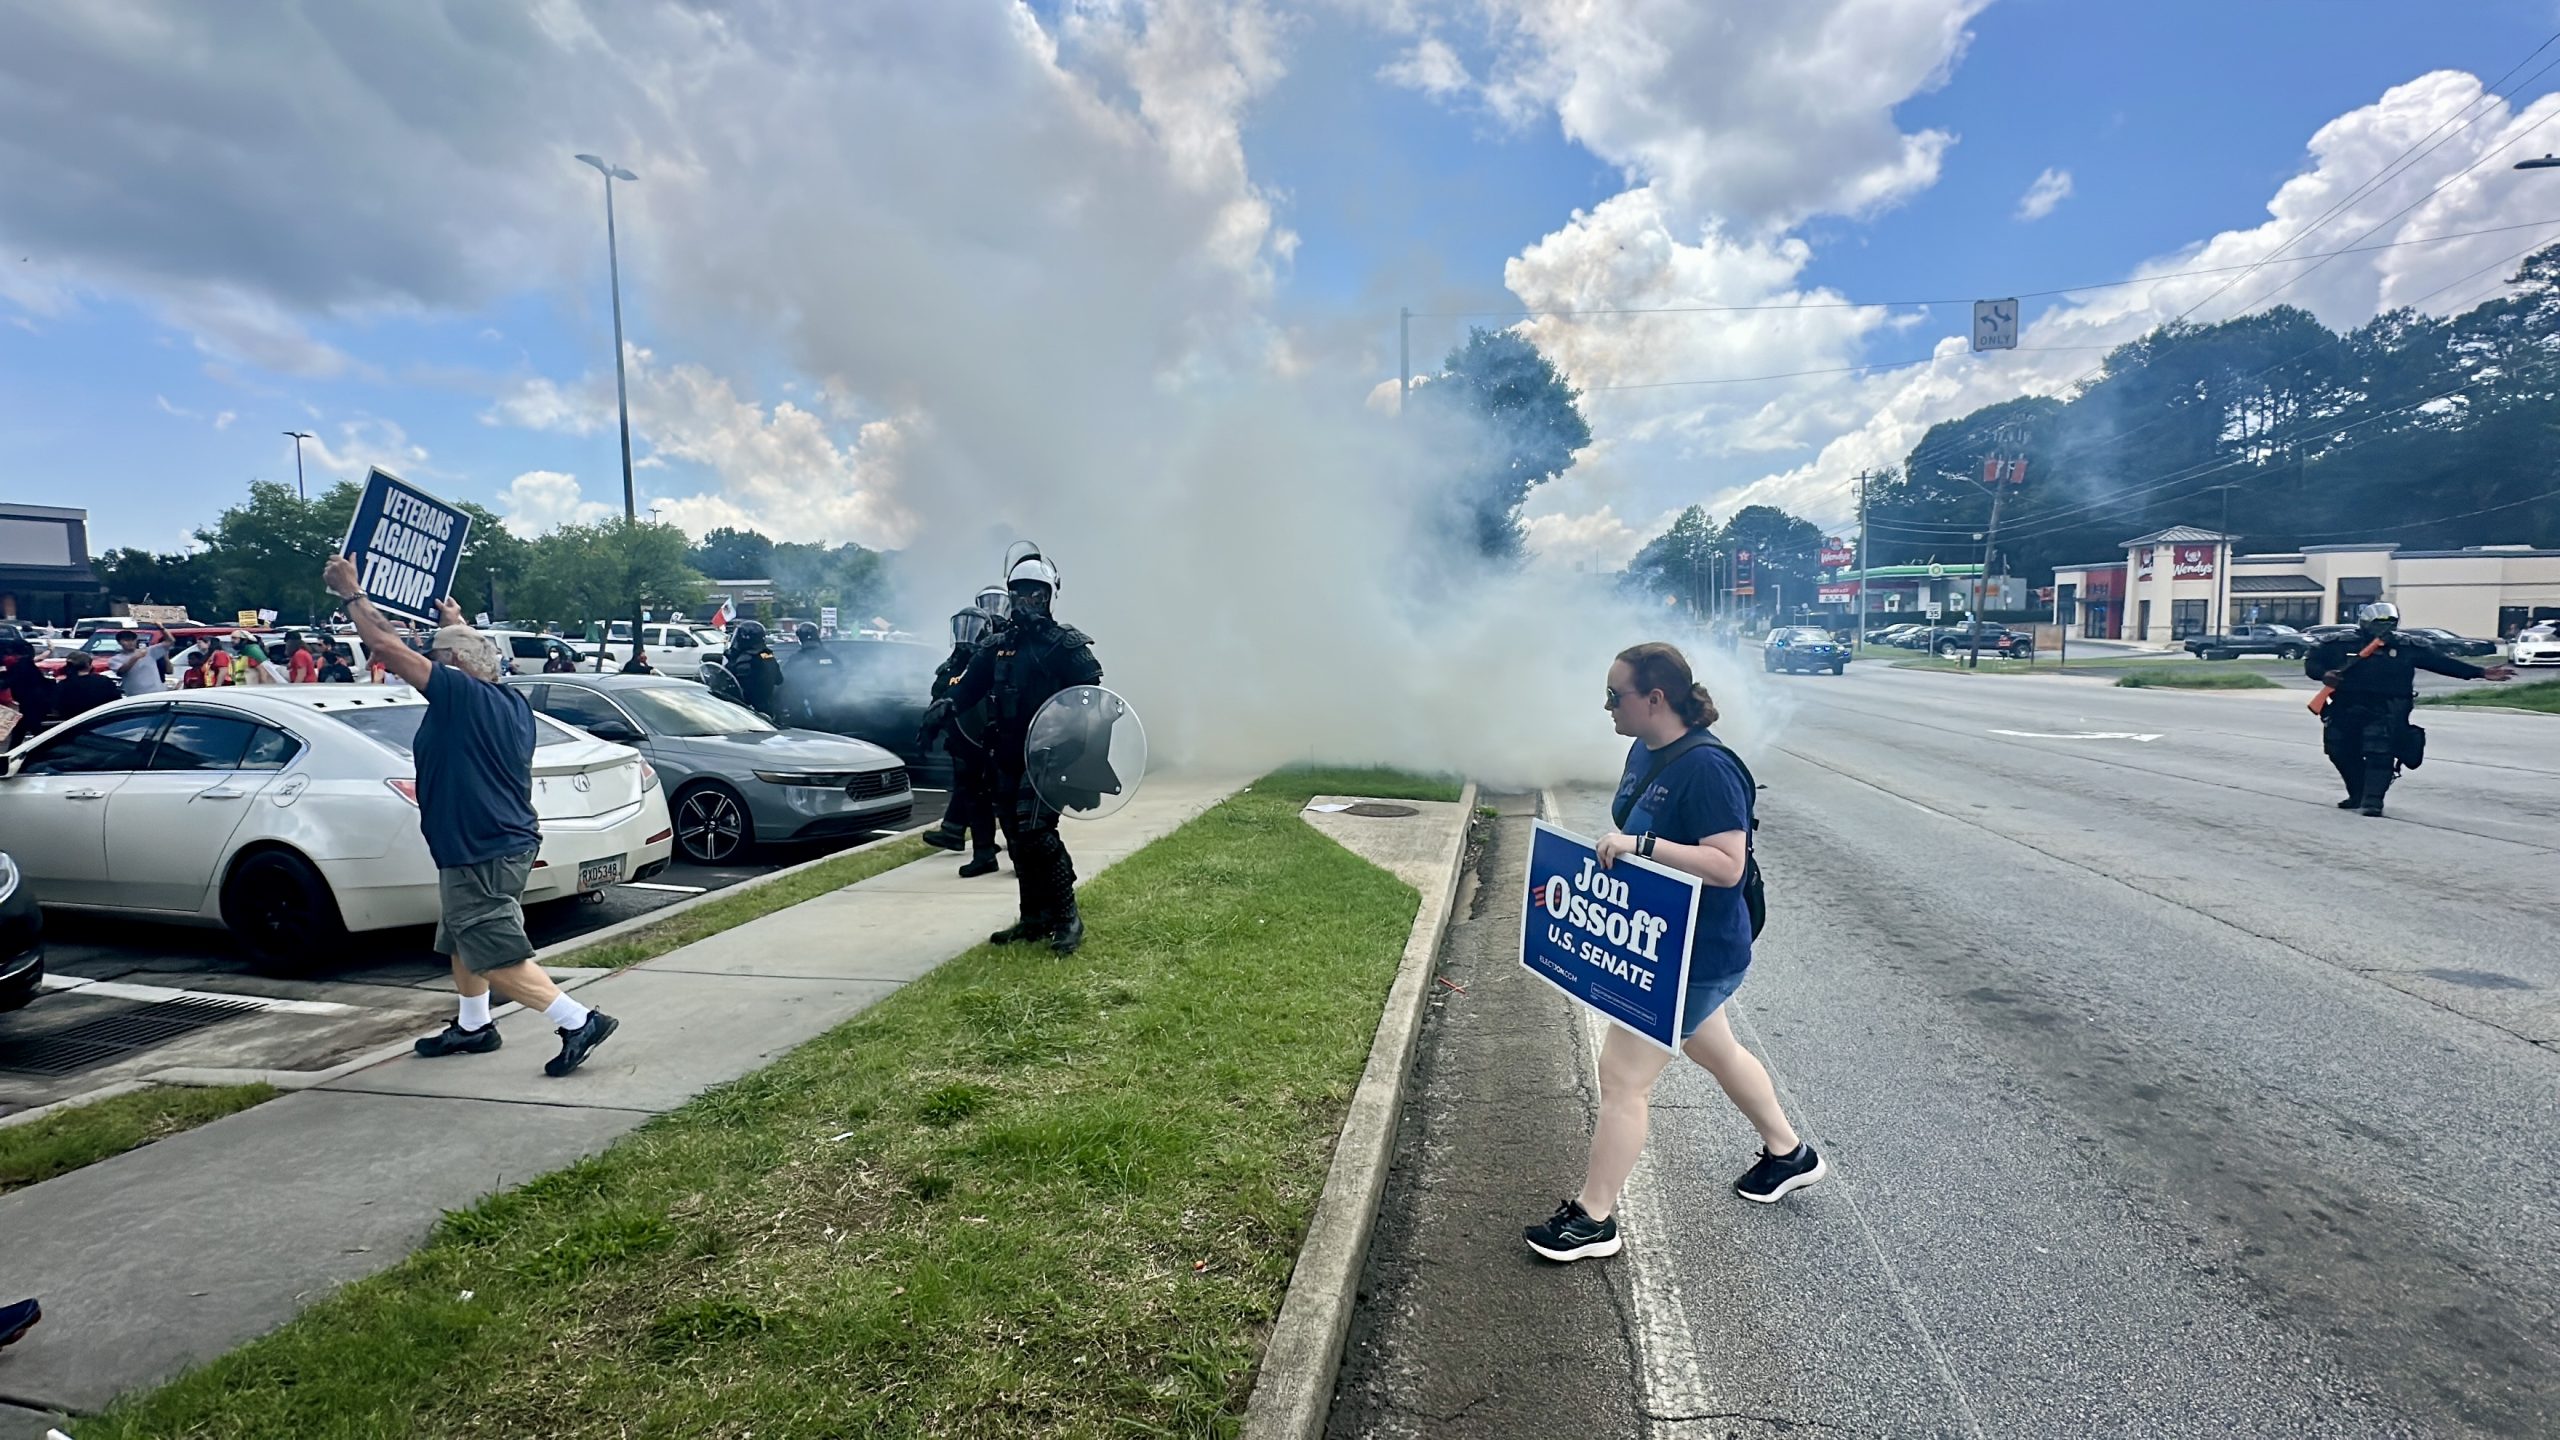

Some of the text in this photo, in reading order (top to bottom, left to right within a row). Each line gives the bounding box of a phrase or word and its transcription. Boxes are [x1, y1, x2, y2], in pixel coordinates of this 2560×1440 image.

[1980, 335, 2010, 345] ONLY
[382, 486, 454, 541] VETERANS
[369, 517, 446, 573] AGAINST
[2173, 561, 2213, 577] Wendy's
[360, 551, 435, 610] TRUMP
[1929, 610, 1940, 618] 35
[1574, 857, 1629, 910] Jon
[1545, 875, 1668, 963] Ossoff
[1547, 923, 1655, 992] U.S. SENATE
